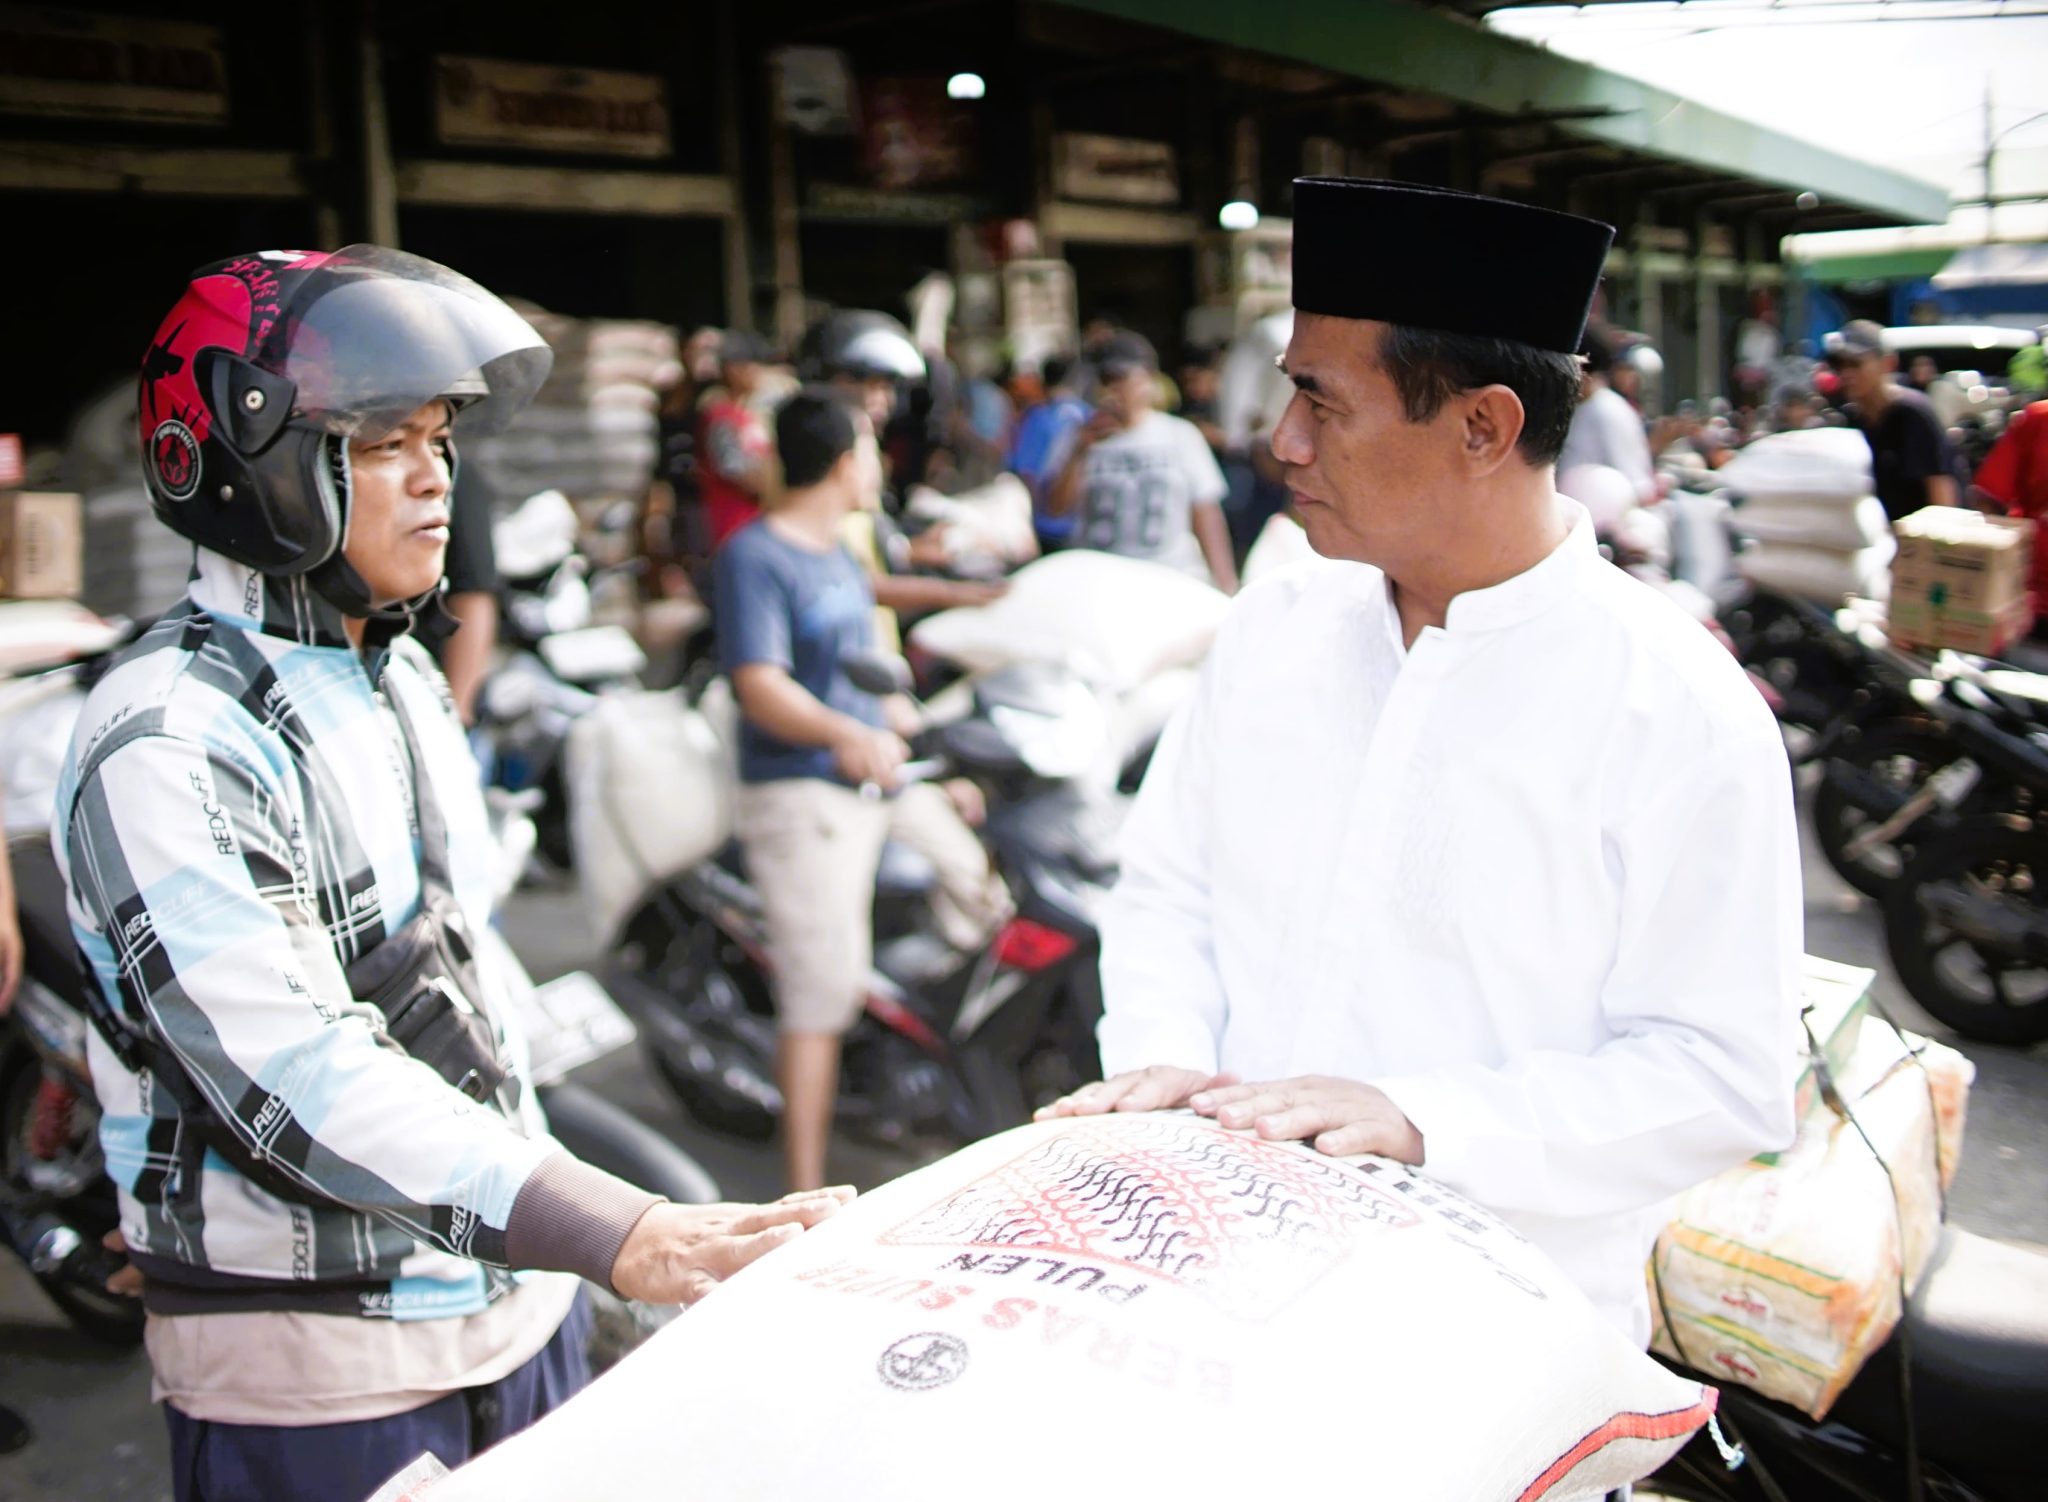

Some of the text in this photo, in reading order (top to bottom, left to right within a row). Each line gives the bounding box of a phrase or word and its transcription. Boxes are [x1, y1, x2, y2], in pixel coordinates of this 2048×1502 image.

[936, 1251, 1149, 1306] PULEN
[794, 1257, 1234, 1408] BERAS SUPER
